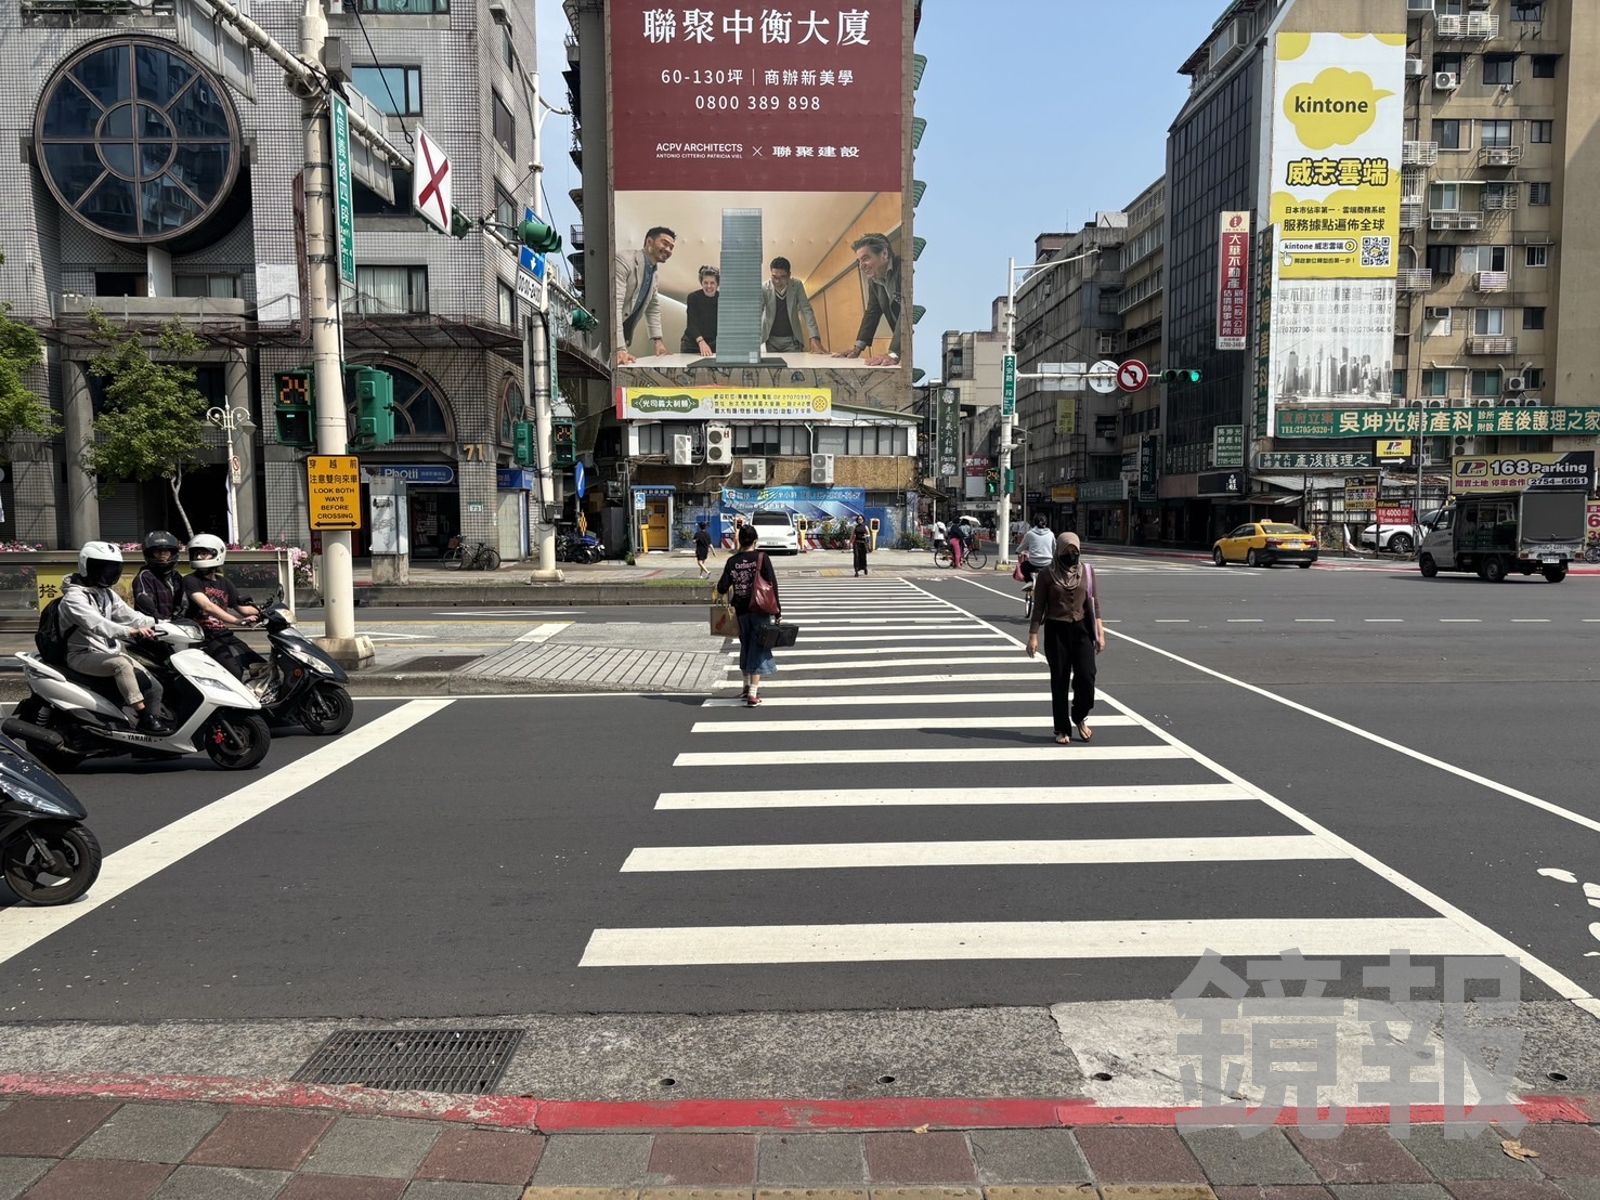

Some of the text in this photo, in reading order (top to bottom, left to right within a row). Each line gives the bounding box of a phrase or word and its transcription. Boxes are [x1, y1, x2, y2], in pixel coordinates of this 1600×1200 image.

[642, 9, 871, 46] 聯聚中衡大廈
[764, 69, 854, 87] 商辦新美學
[696, 95, 821, 110] 0800 389 898
[1295, 96, 1368, 113] kintone
[656, 143, 743, 152] ACPV ARCHITECTS
[772, 146, 860, 158] 聯聚建設
[1286, 157, 1389, 186] 威志雲端
[1283, 218, 1385, 232] 服務據點遍佈全球
[1284, 242, 1313, 250] kintone
[1228, 233, 1241, 289] 大華不動產
[280, 376, 309, 404] 24
[1339, 411, 1473, 433] 吳坤光婦產科
[1497, 410, 1600, 432] 產後護理之家
[464, 444, 483, 461] 71
[310, 474, 358, 484] 注意雙向來車
